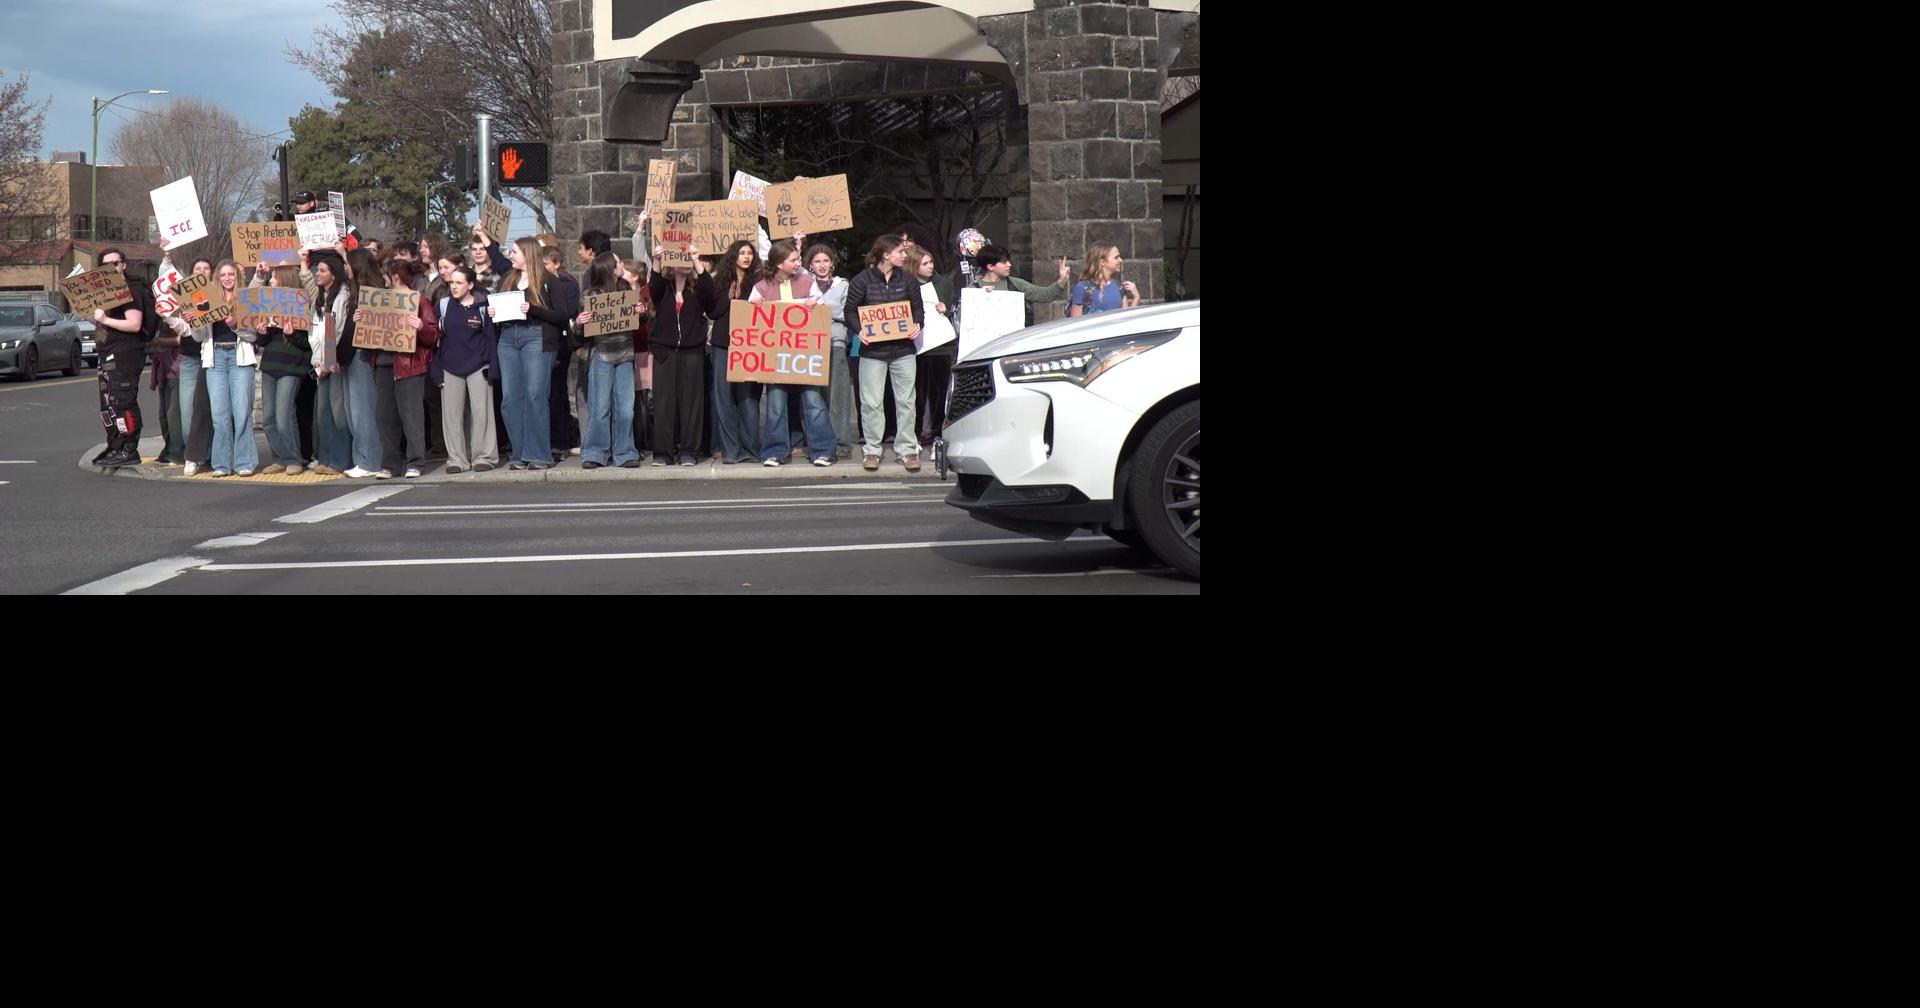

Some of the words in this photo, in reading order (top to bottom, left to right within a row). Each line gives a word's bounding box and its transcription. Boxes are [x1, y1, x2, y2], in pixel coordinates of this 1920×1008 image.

[776, 203, 792, 213] NO
[484, 213, 502, 238] ICE
[665, 211, 693, 224] STOP
[169, 219, 193, 237] ICE
[237, 226, 261, 241] Stop
[245, 241, 261, 250] Your
[264, 237, 294, 250] RACISM
[662, 231, 693, 244] KILLING
[664, 250, 693, 262] PEOPLE
[62, 280, 80, 293] You
[170, 273, 208, 296] VETO
[181, 302, 194, 311] the
[359, 289, 393, 307] ICE
[394, 292, 418, 312] IS
[590, 292, 626, 311] Protect
[191, 305, 230, 328] CHEETO
[619, 303, 638, 317] NOT
[751, 303, 810, 329] NO
[861, 304, 909, 323] ABOLISH
[600, 319, 631, 334] POWER
[864, 320, 908, 337] ICE
[354, 327, 415, 350] ENERGY
[731, 328, 828, 350] SECRET
[729, 350, 824, 377] POLICE
